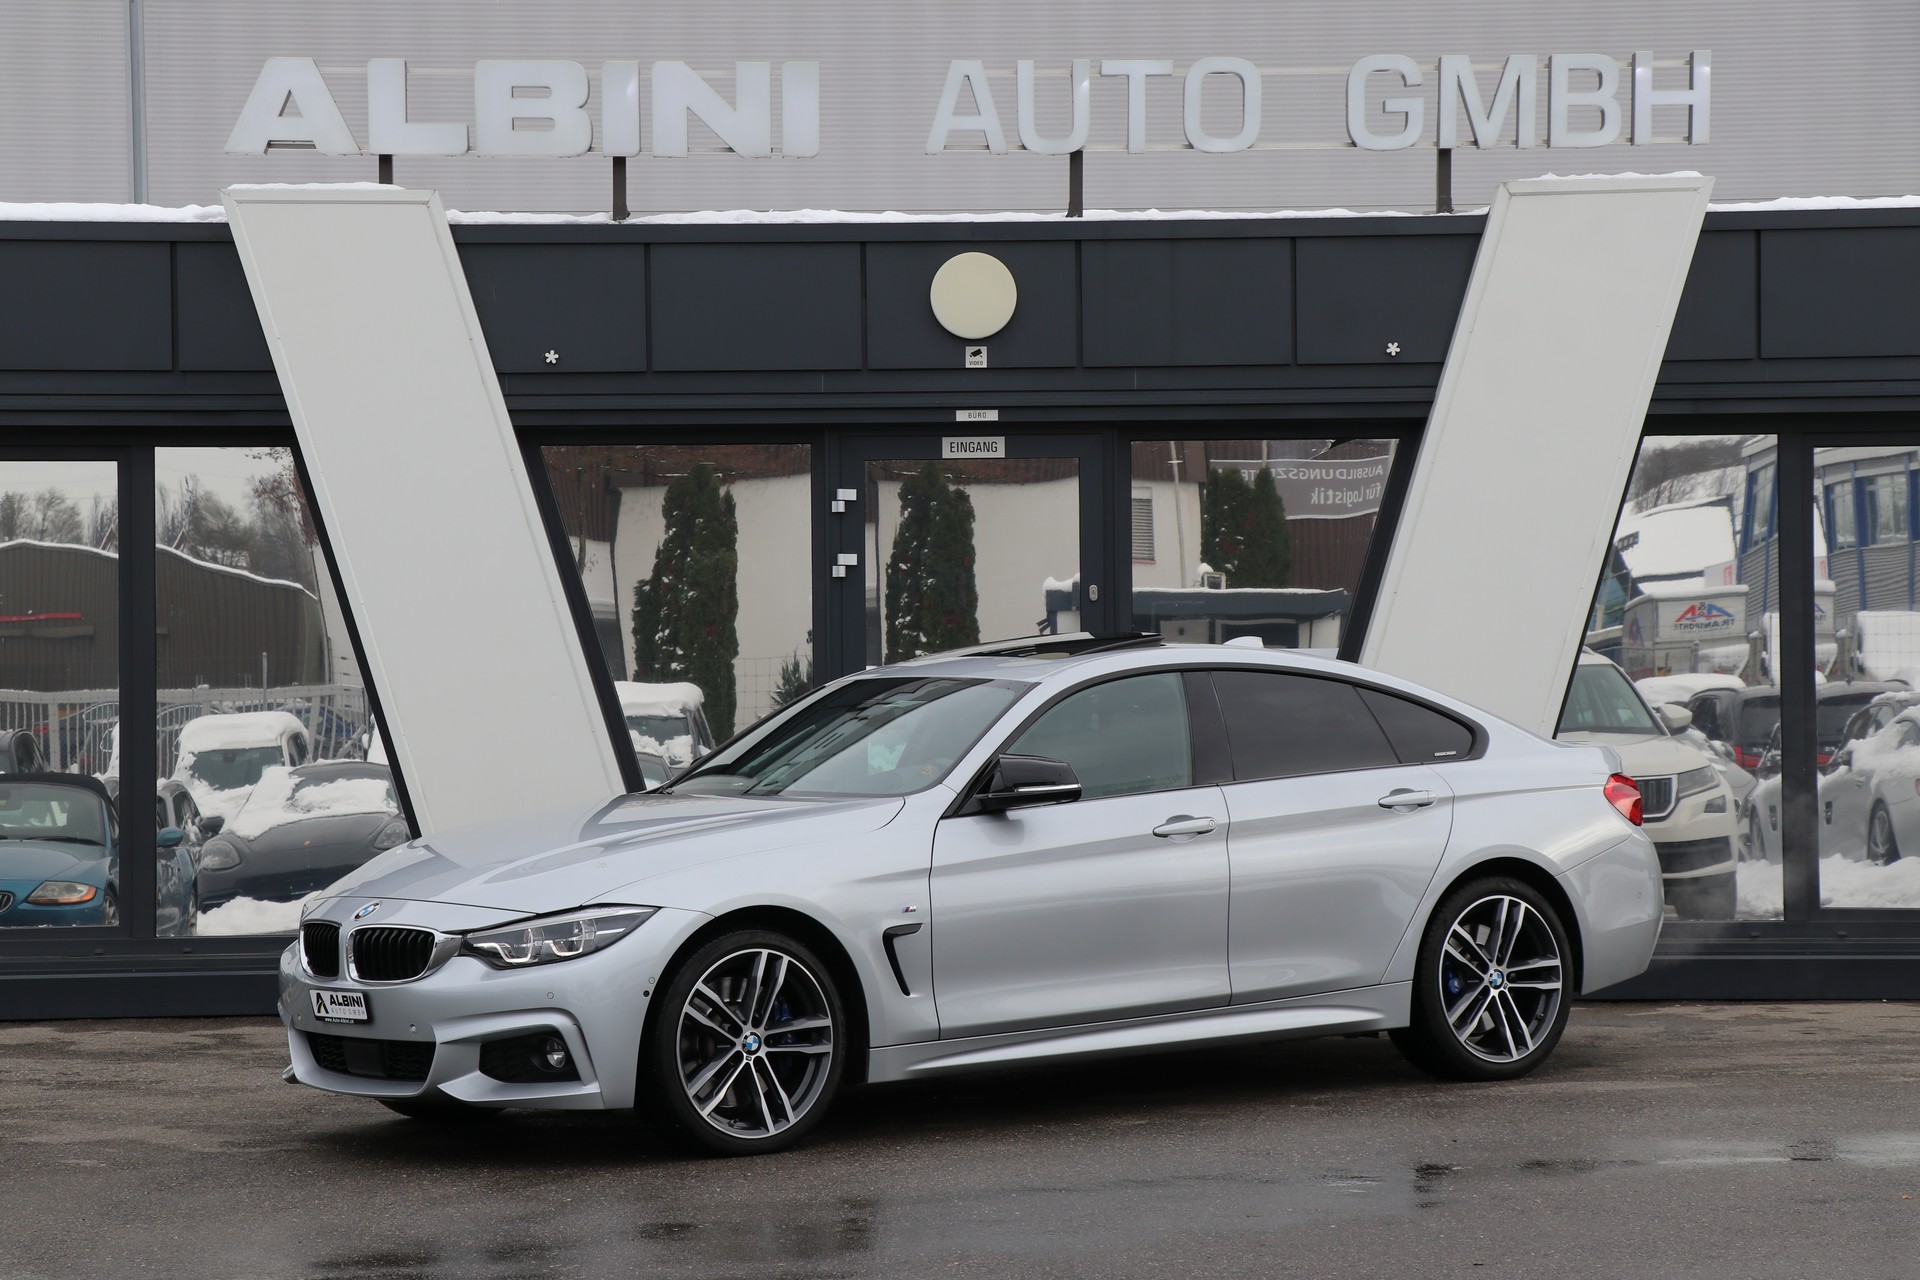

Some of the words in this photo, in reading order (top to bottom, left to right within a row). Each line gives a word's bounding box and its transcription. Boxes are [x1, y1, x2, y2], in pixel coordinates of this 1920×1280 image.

[224, 56, 820, 158] ALBINI
[925, 56, 1263, 155] AUTO
[1345, 49, 1712, 152] GMBH
[968, 411, 987, 419] BÜRO
[950, 441, 998, 453] EINGANG
[330, 994, 363, 1007] ALBINI
